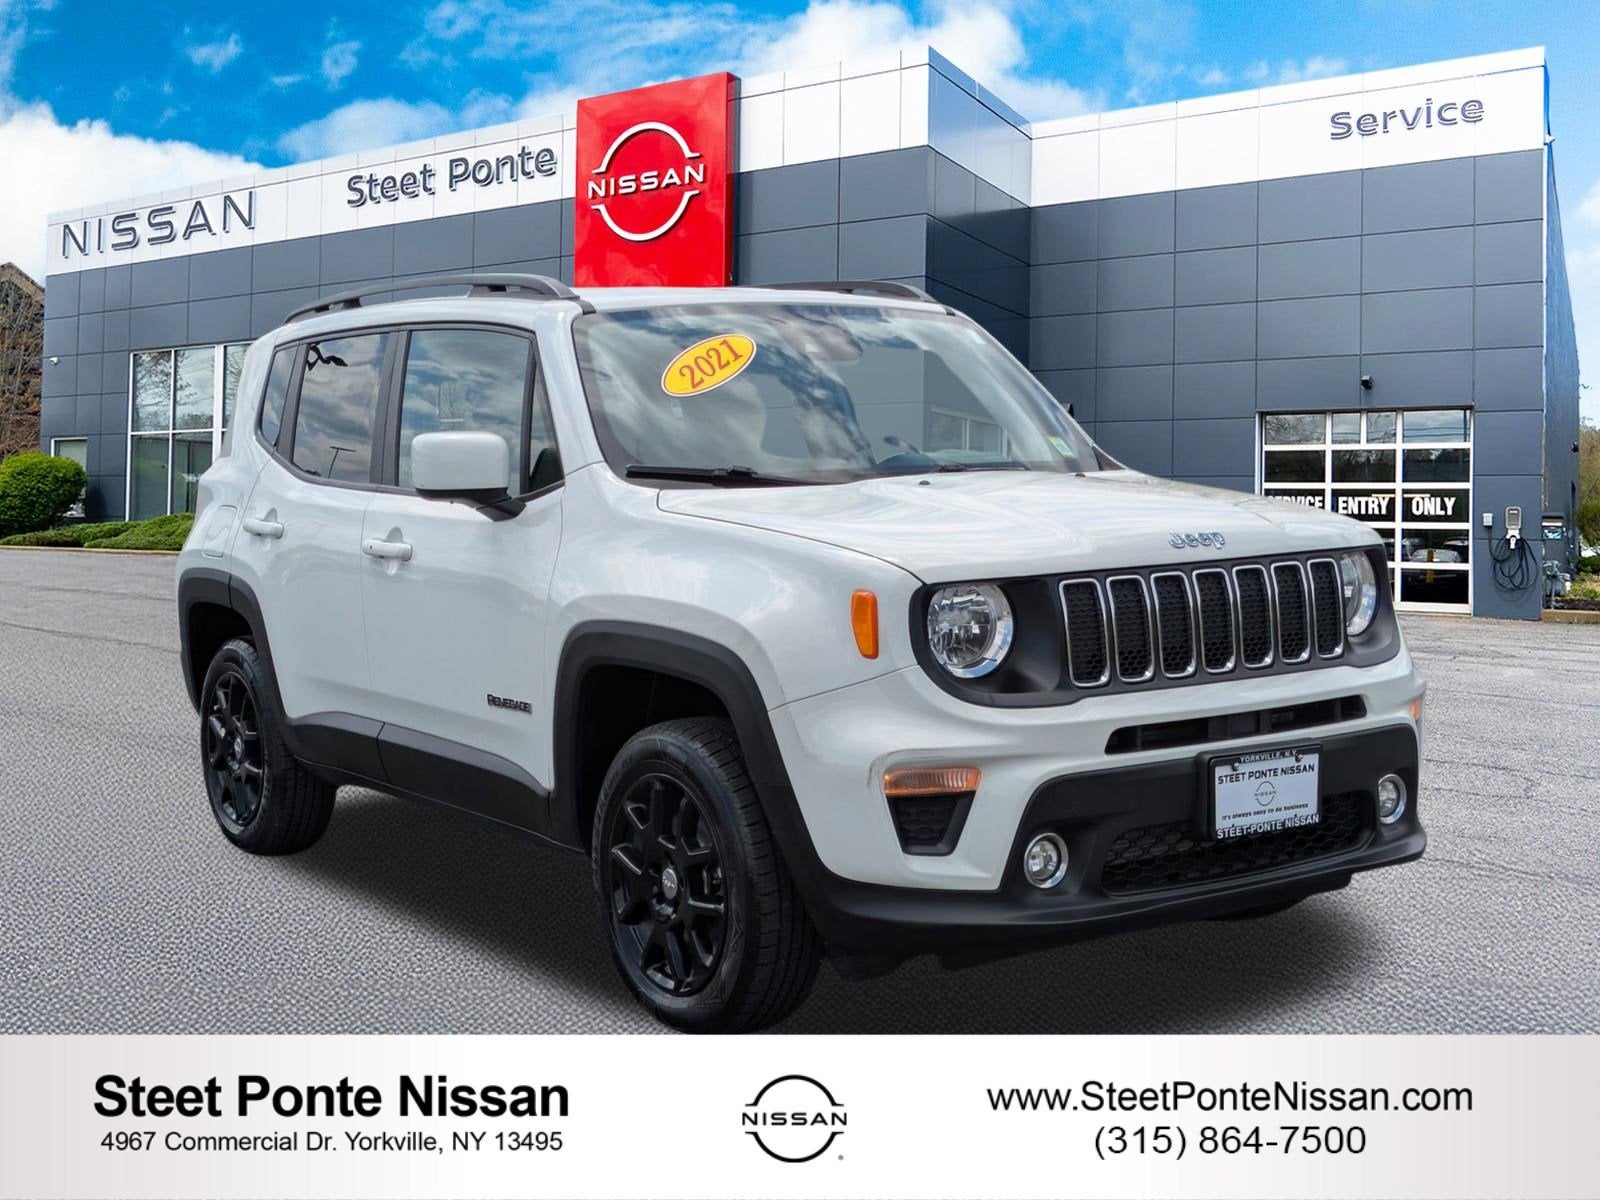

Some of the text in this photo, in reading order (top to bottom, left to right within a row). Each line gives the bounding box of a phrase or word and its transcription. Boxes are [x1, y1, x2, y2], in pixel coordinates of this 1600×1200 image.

[1331, 98, 1485, 140] Service
[347, 146, 557, 207] Steet Ponte
[587, 163, 704, 199] NISSAN
[62, 190, 256, 258] NISSAN
[679, 339, 743, 389] 2021
[1338, 496, 1390, 515] ENTRY
[1411, 497, 1456, 516] ONLY
[1168, 530, 1226, 550] Jeep
[1218, 764, 1315, 785] STEET PONTE NISSAN
[1285, 814, 1319, 828] NISSAN
